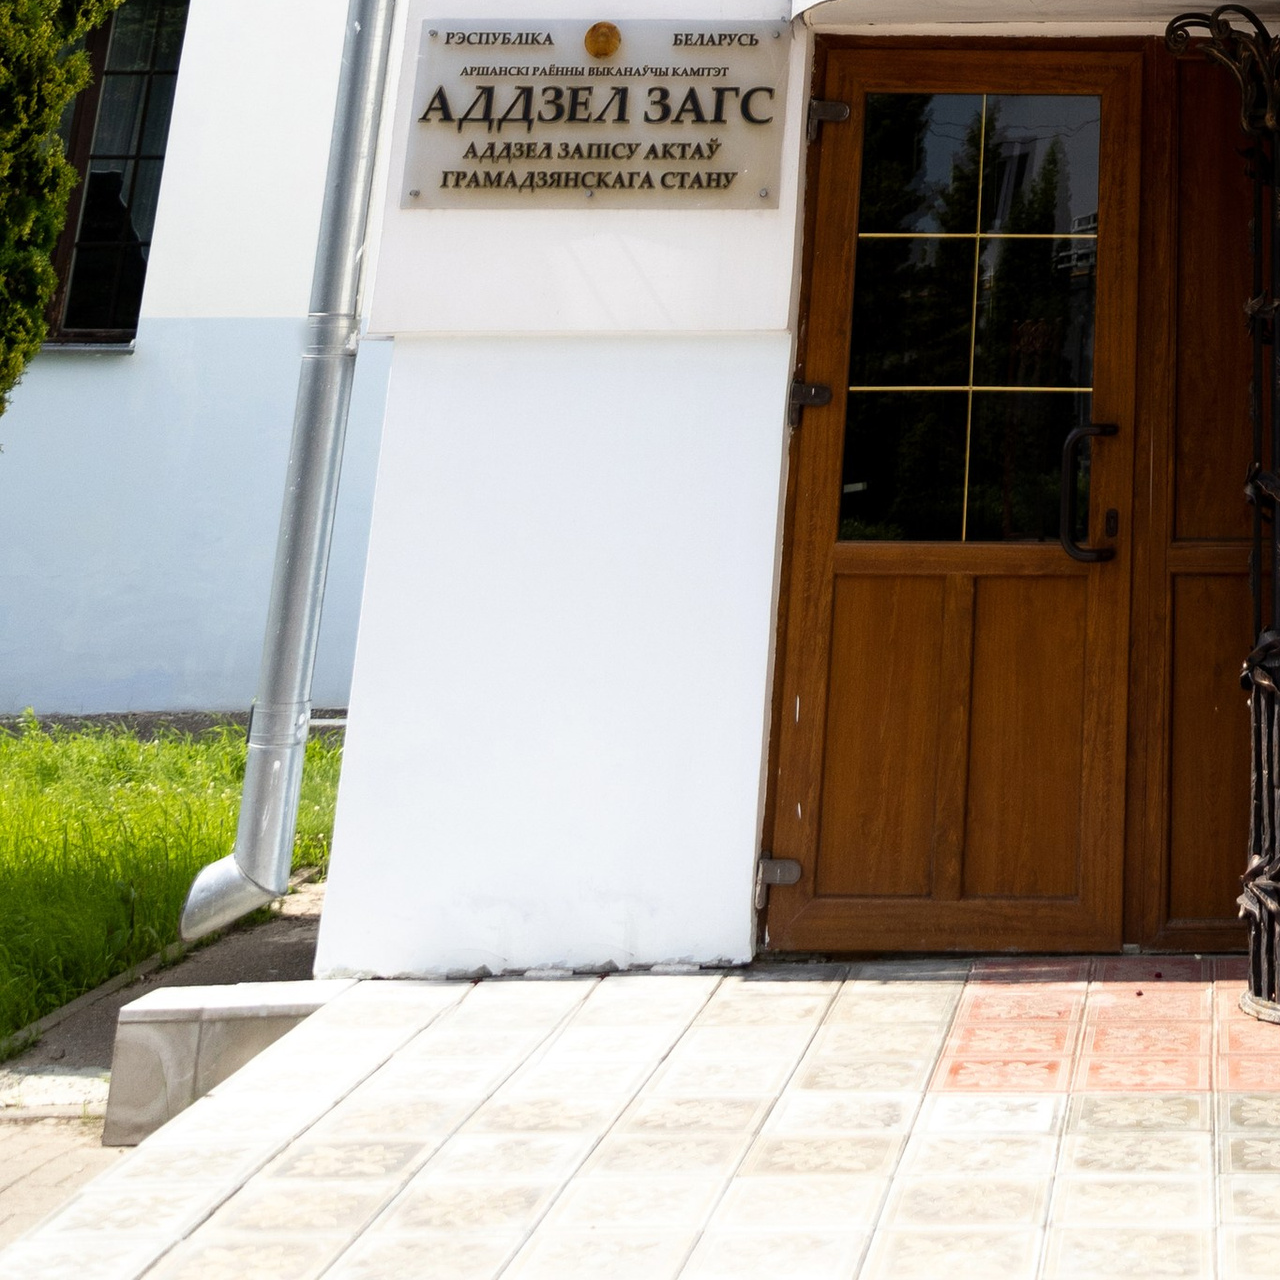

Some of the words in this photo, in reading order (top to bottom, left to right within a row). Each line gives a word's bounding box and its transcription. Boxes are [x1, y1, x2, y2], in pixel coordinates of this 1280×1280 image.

[444, 31, 555, 46] РЭСПУБЛІКА
[672, 32, 759, 47] БЕЛАРУСЬ
[460, 66, 530, 76] АРШАНСКІ
[532, 64, 585, 76] РАЁННЫ
[588, 64, 669, 76] ВЫКАНАЎЧЫ
[671, 66, 729, 76] КАМІТЭТ
[418, 85, 630, 133] АДДЗЕЛ
[643, 86, 775, 124] ЗАГС
[463, 141, 553, 163] АДДЗЕЛ
[557, 142, 640, 160] ЗАПІСУ
[643, 138, 722, 160] АКТАЎ
[440, 171, 656, 192] ГРАМАДЗЯНСКАГА
[660, 171, 738, 189] СТАНУ
